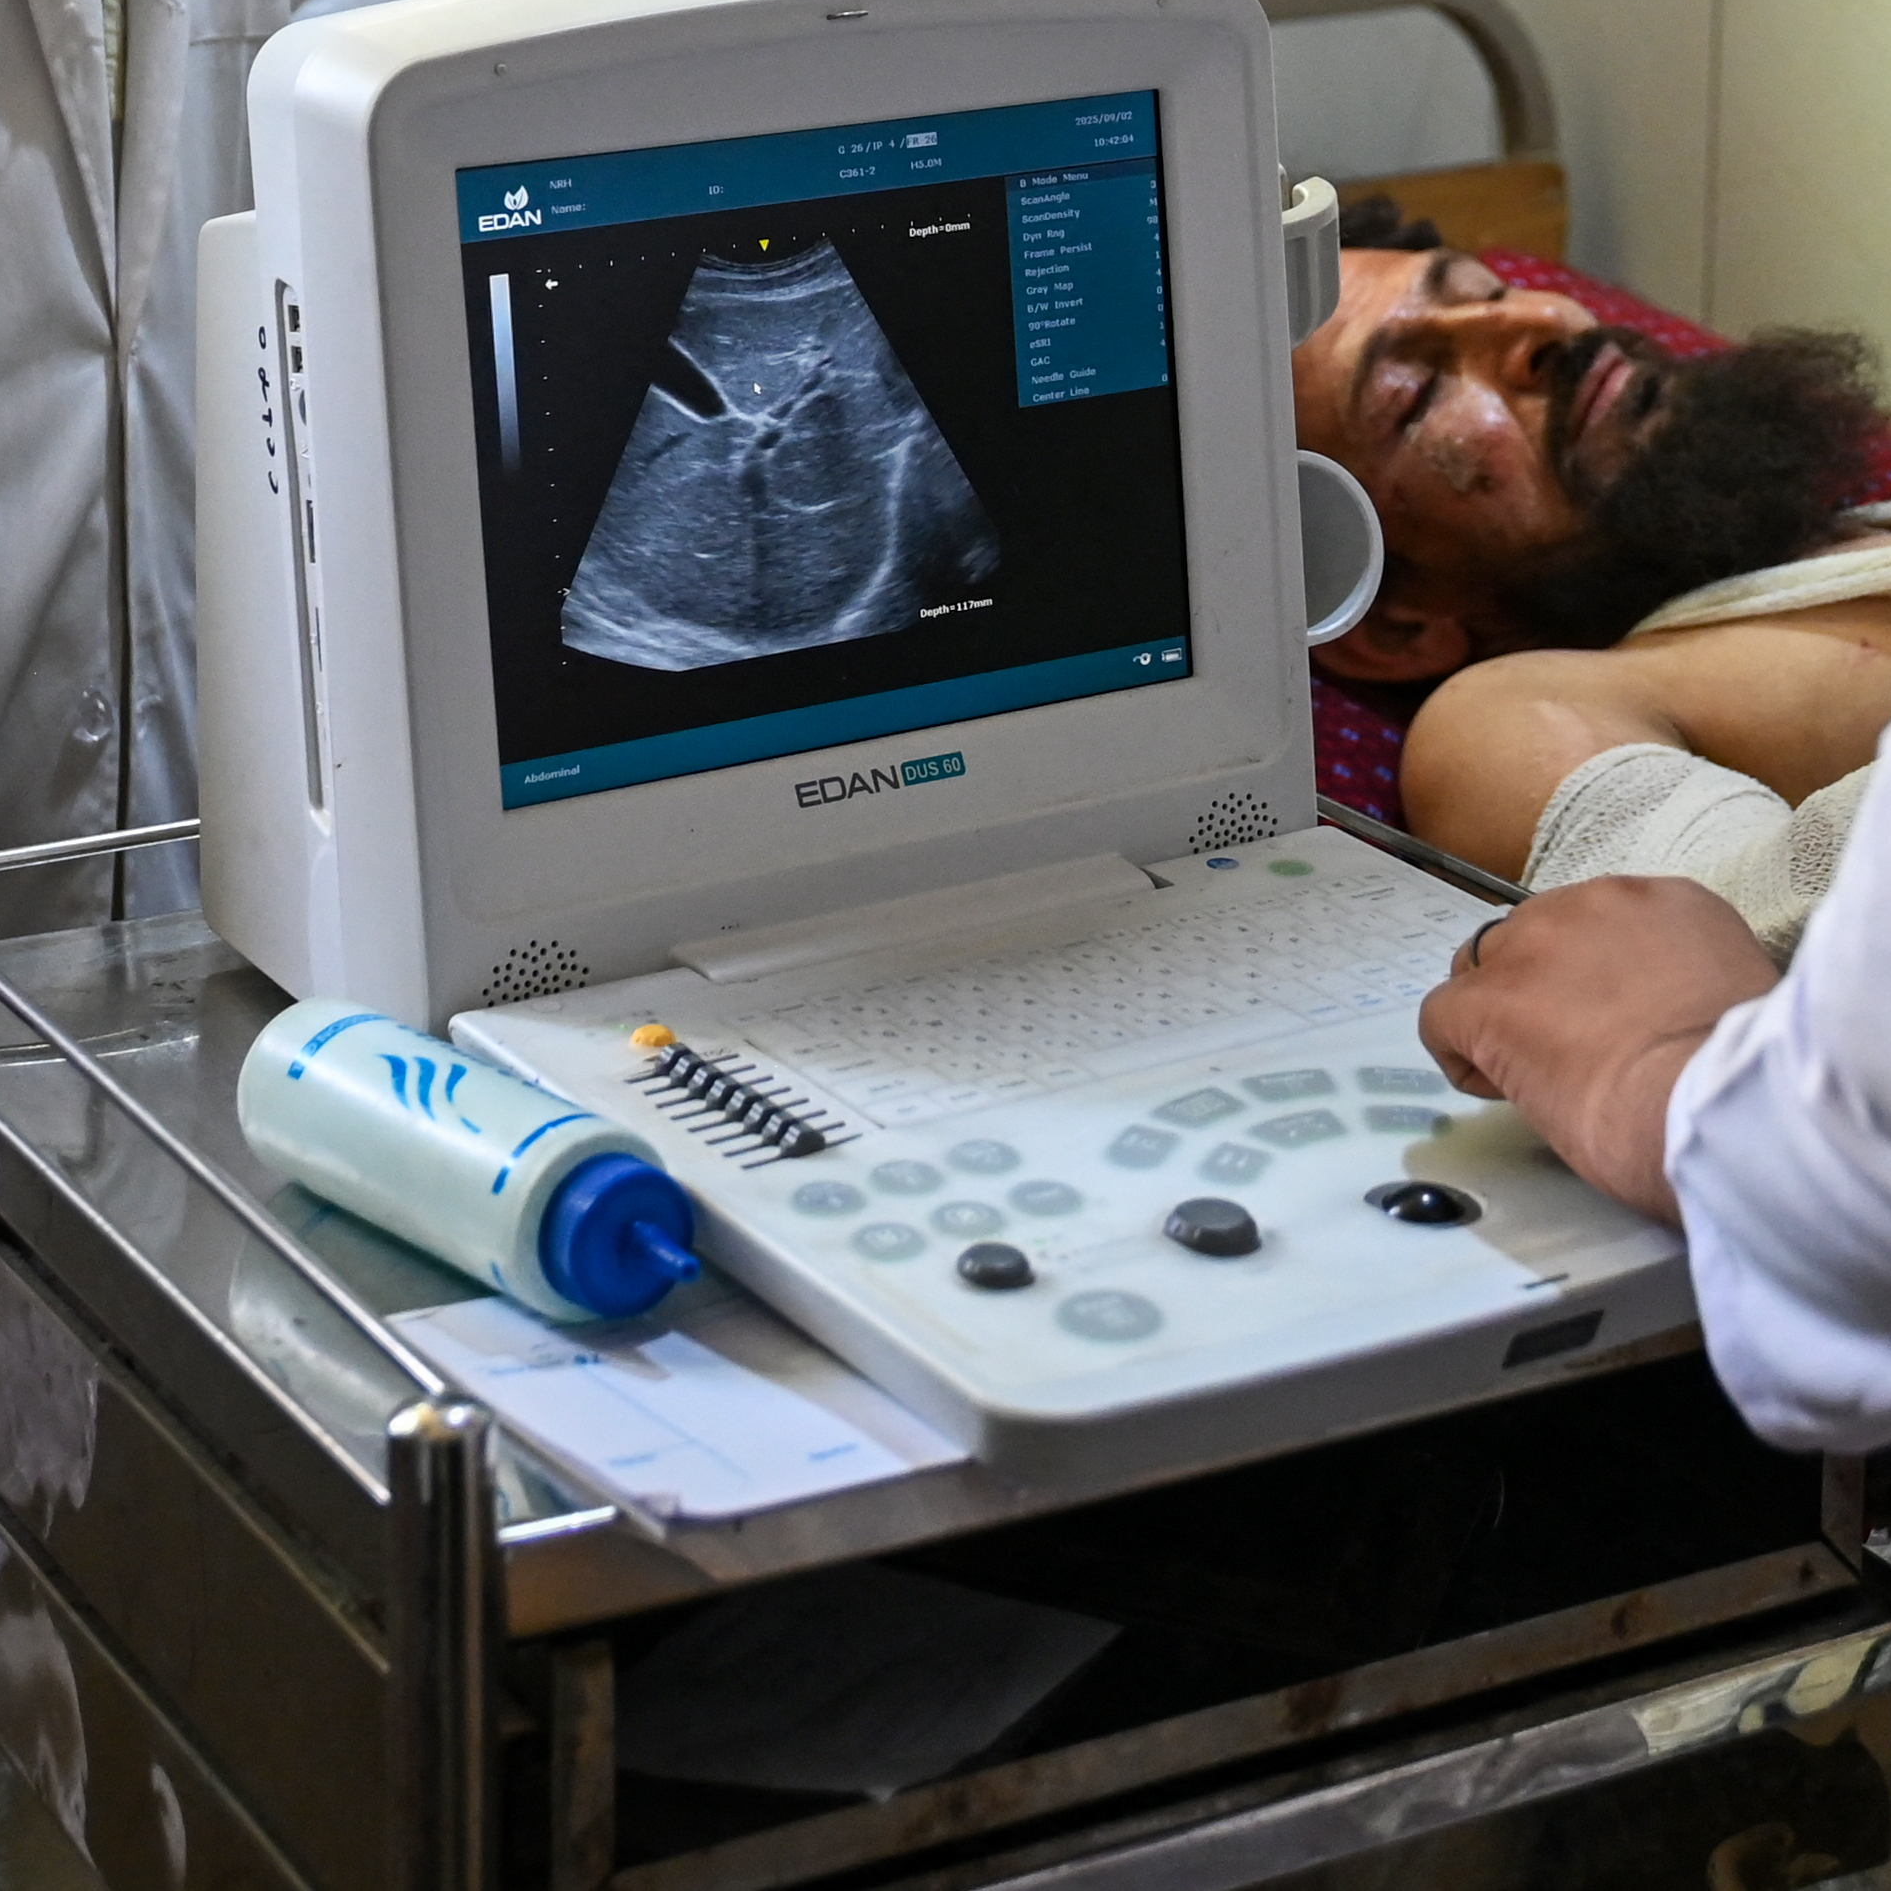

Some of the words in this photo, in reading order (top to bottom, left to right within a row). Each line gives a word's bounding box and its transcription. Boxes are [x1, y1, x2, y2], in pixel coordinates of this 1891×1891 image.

[1094, 133, 1135, 147] 10:42:04
[549, 178, 572, 190] NRH
[1032, 175, 1058, 187] Mode
[1062, 172, 1089, 182] Menu
[551, 202, 586, 215] Name:
[708, 185, 724, 196] ID:
[1021, 191, 1071, 206] ScanAngle
[478, 209, 542, 232] EDAN
[1022, 208, 1081, 224] ScanDensity
[1023, 231, 1042, 243] Dyn
[1047, 229, 1065, 240] Rng
[1024, 248, 1055, 259] Frame
[1060, 242, 1093, 255] Persist
[1025, 263, 1070, 278] Rejection
[1026, 284, 1048, 296] Gray
[1053, 281, 1074, 292] Map
[1027, 302, 1049, 314] B/W
[1054, 297, 1084, 310] Invert
[1031, 372, 1064, 385] Needle
[1069, 367, 1097, 380] Guide
[1032, 391, 1065, 403] Center
[1070, 386, 1090, 397] Line
[919, 597, 993, 619] Depth=117mm
[524, 764, 580, 784] Abdominal
[794, 765, 900, 808] EDAN
[904, 760, 939, 782] DUS
[942, 757, 961, 775] 60
